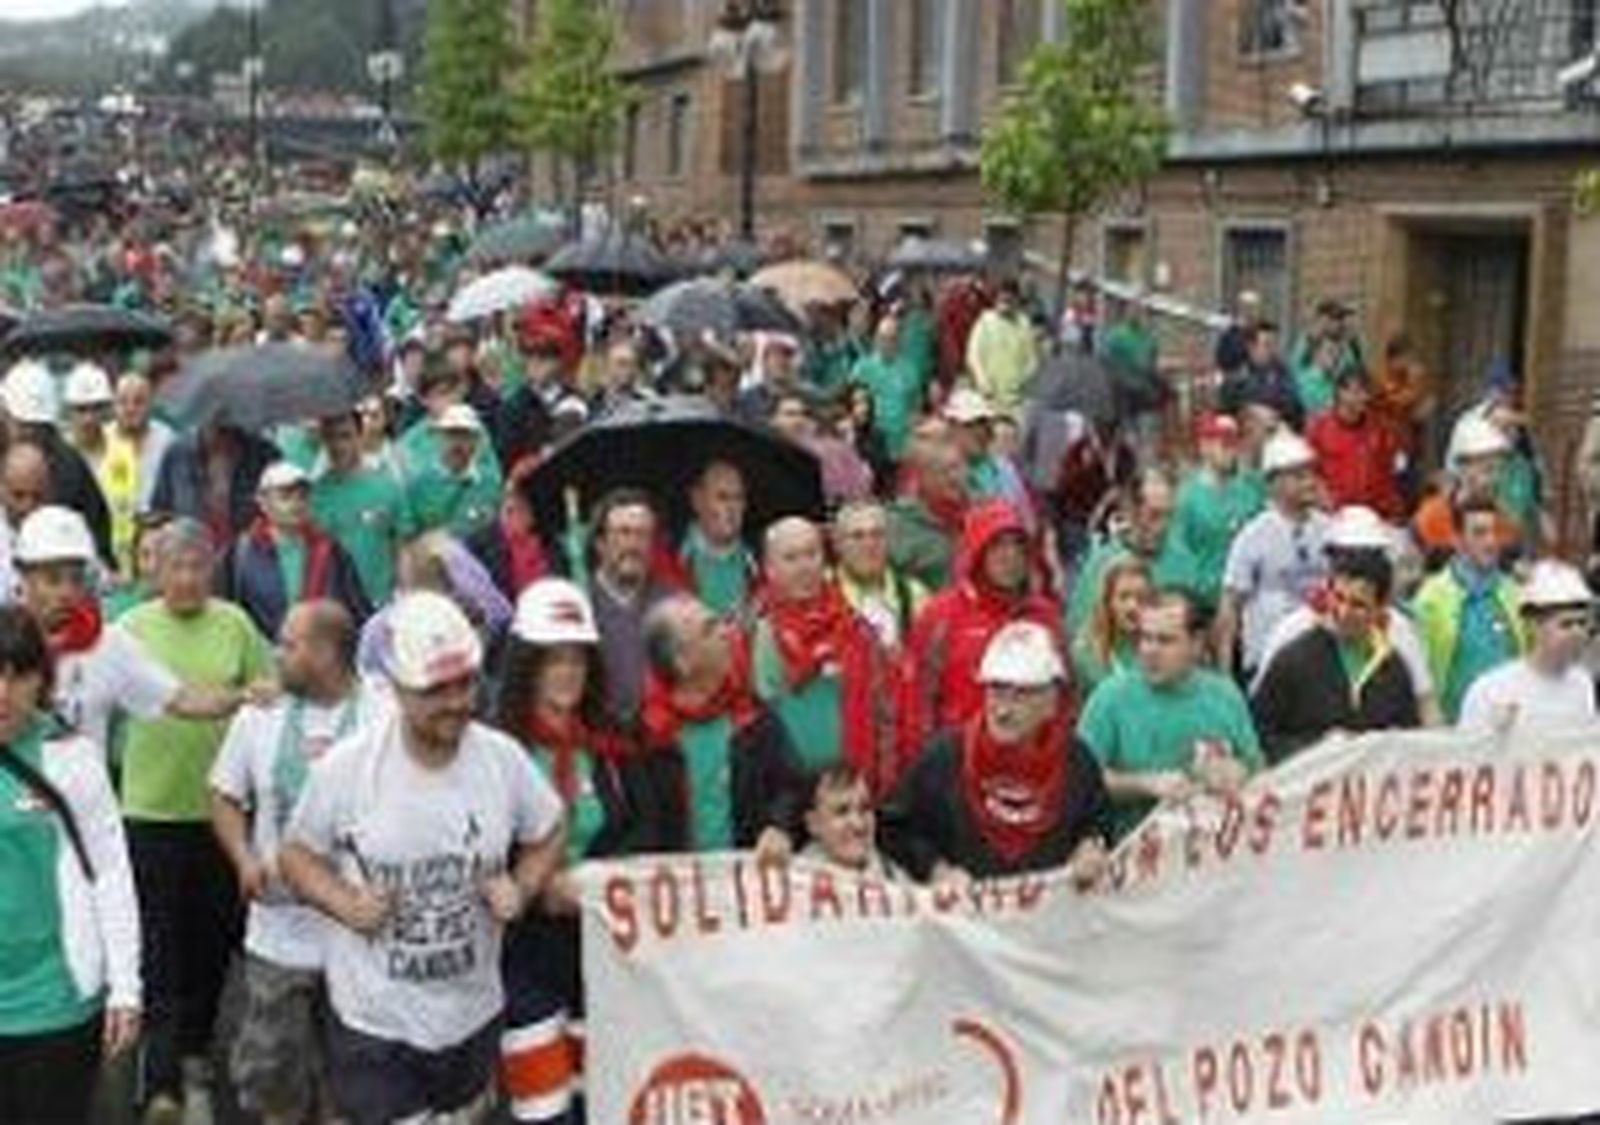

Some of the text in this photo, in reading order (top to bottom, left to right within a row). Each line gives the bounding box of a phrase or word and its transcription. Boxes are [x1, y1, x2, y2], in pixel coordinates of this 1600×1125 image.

[1302, 760, 1596, 849] ENCERRADO
[1193, 1031, 1321, 1117] POZO
[1359, 1002, 1527, 1096] CANDIN
